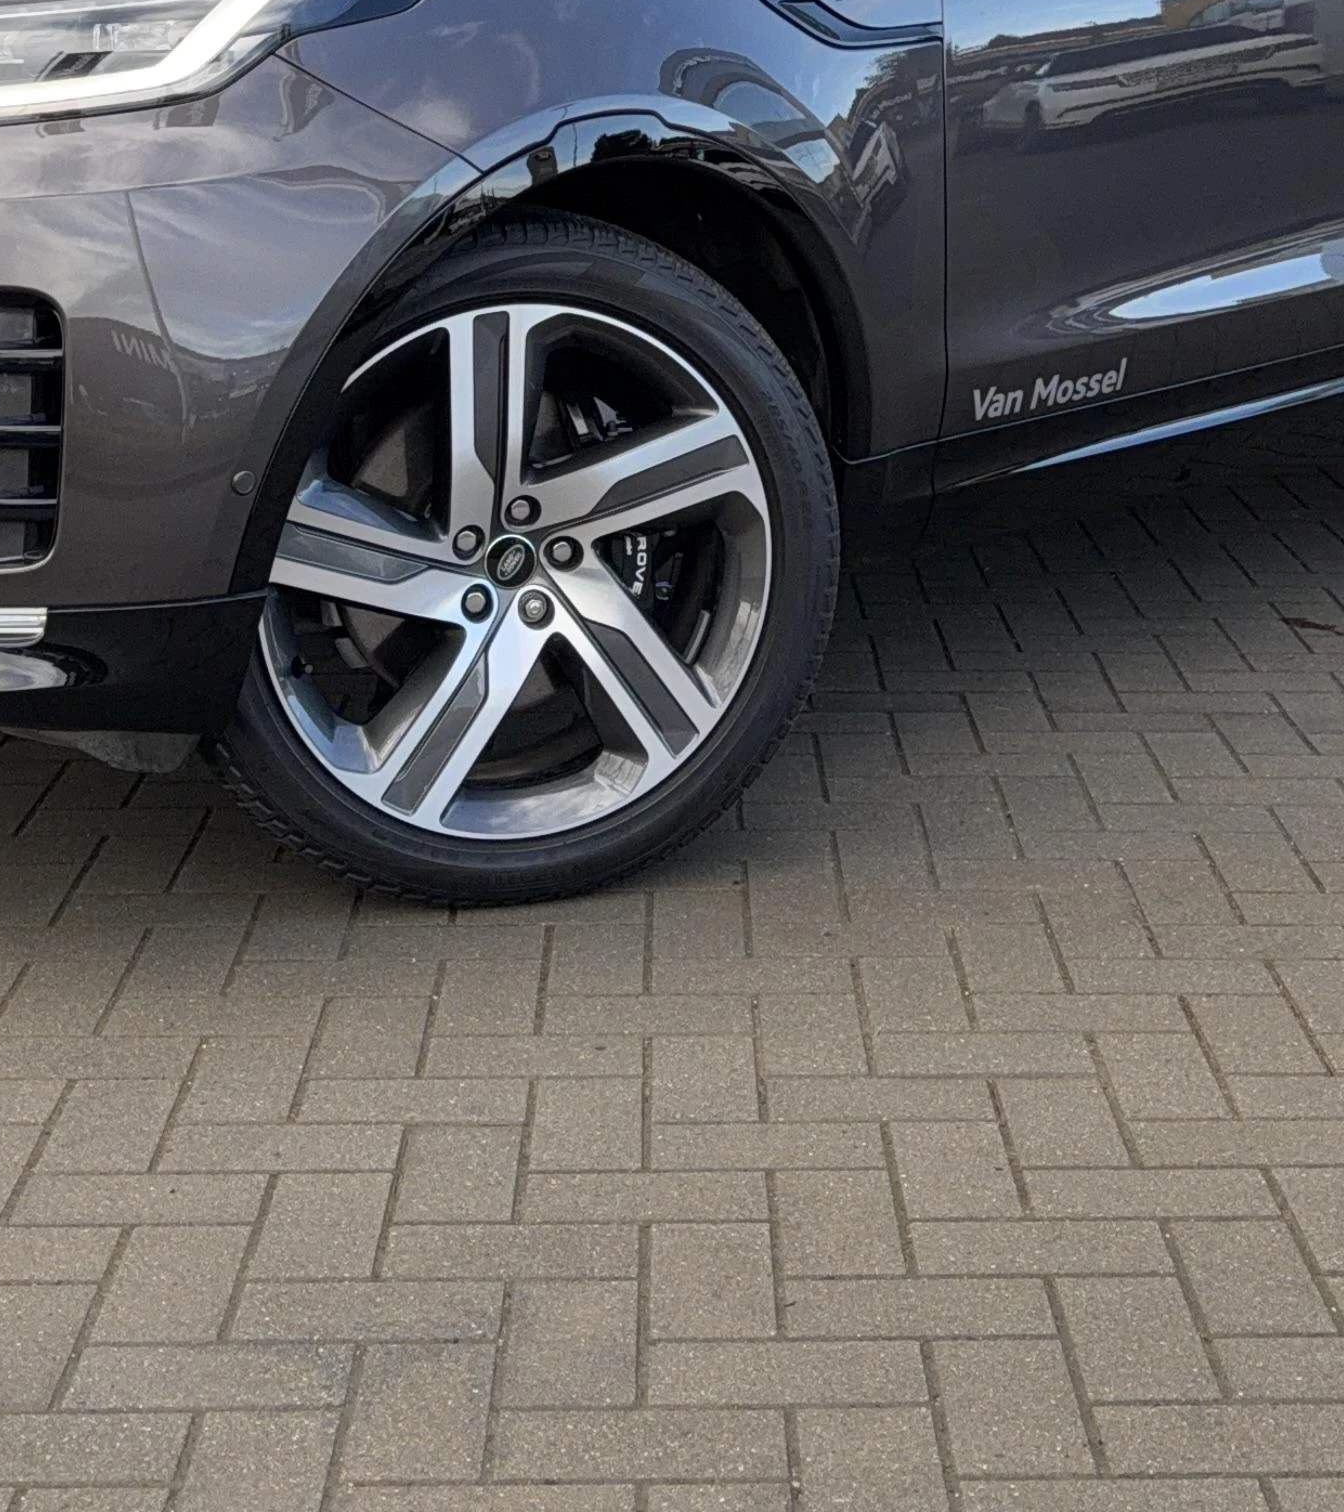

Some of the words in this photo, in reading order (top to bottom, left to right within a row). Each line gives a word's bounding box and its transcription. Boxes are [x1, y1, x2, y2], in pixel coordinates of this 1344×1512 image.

[972, 386, 1024, 421] Van
[1029, 357, 1128, 410] Mossel
[632, 536, 647, 599] ROVE
